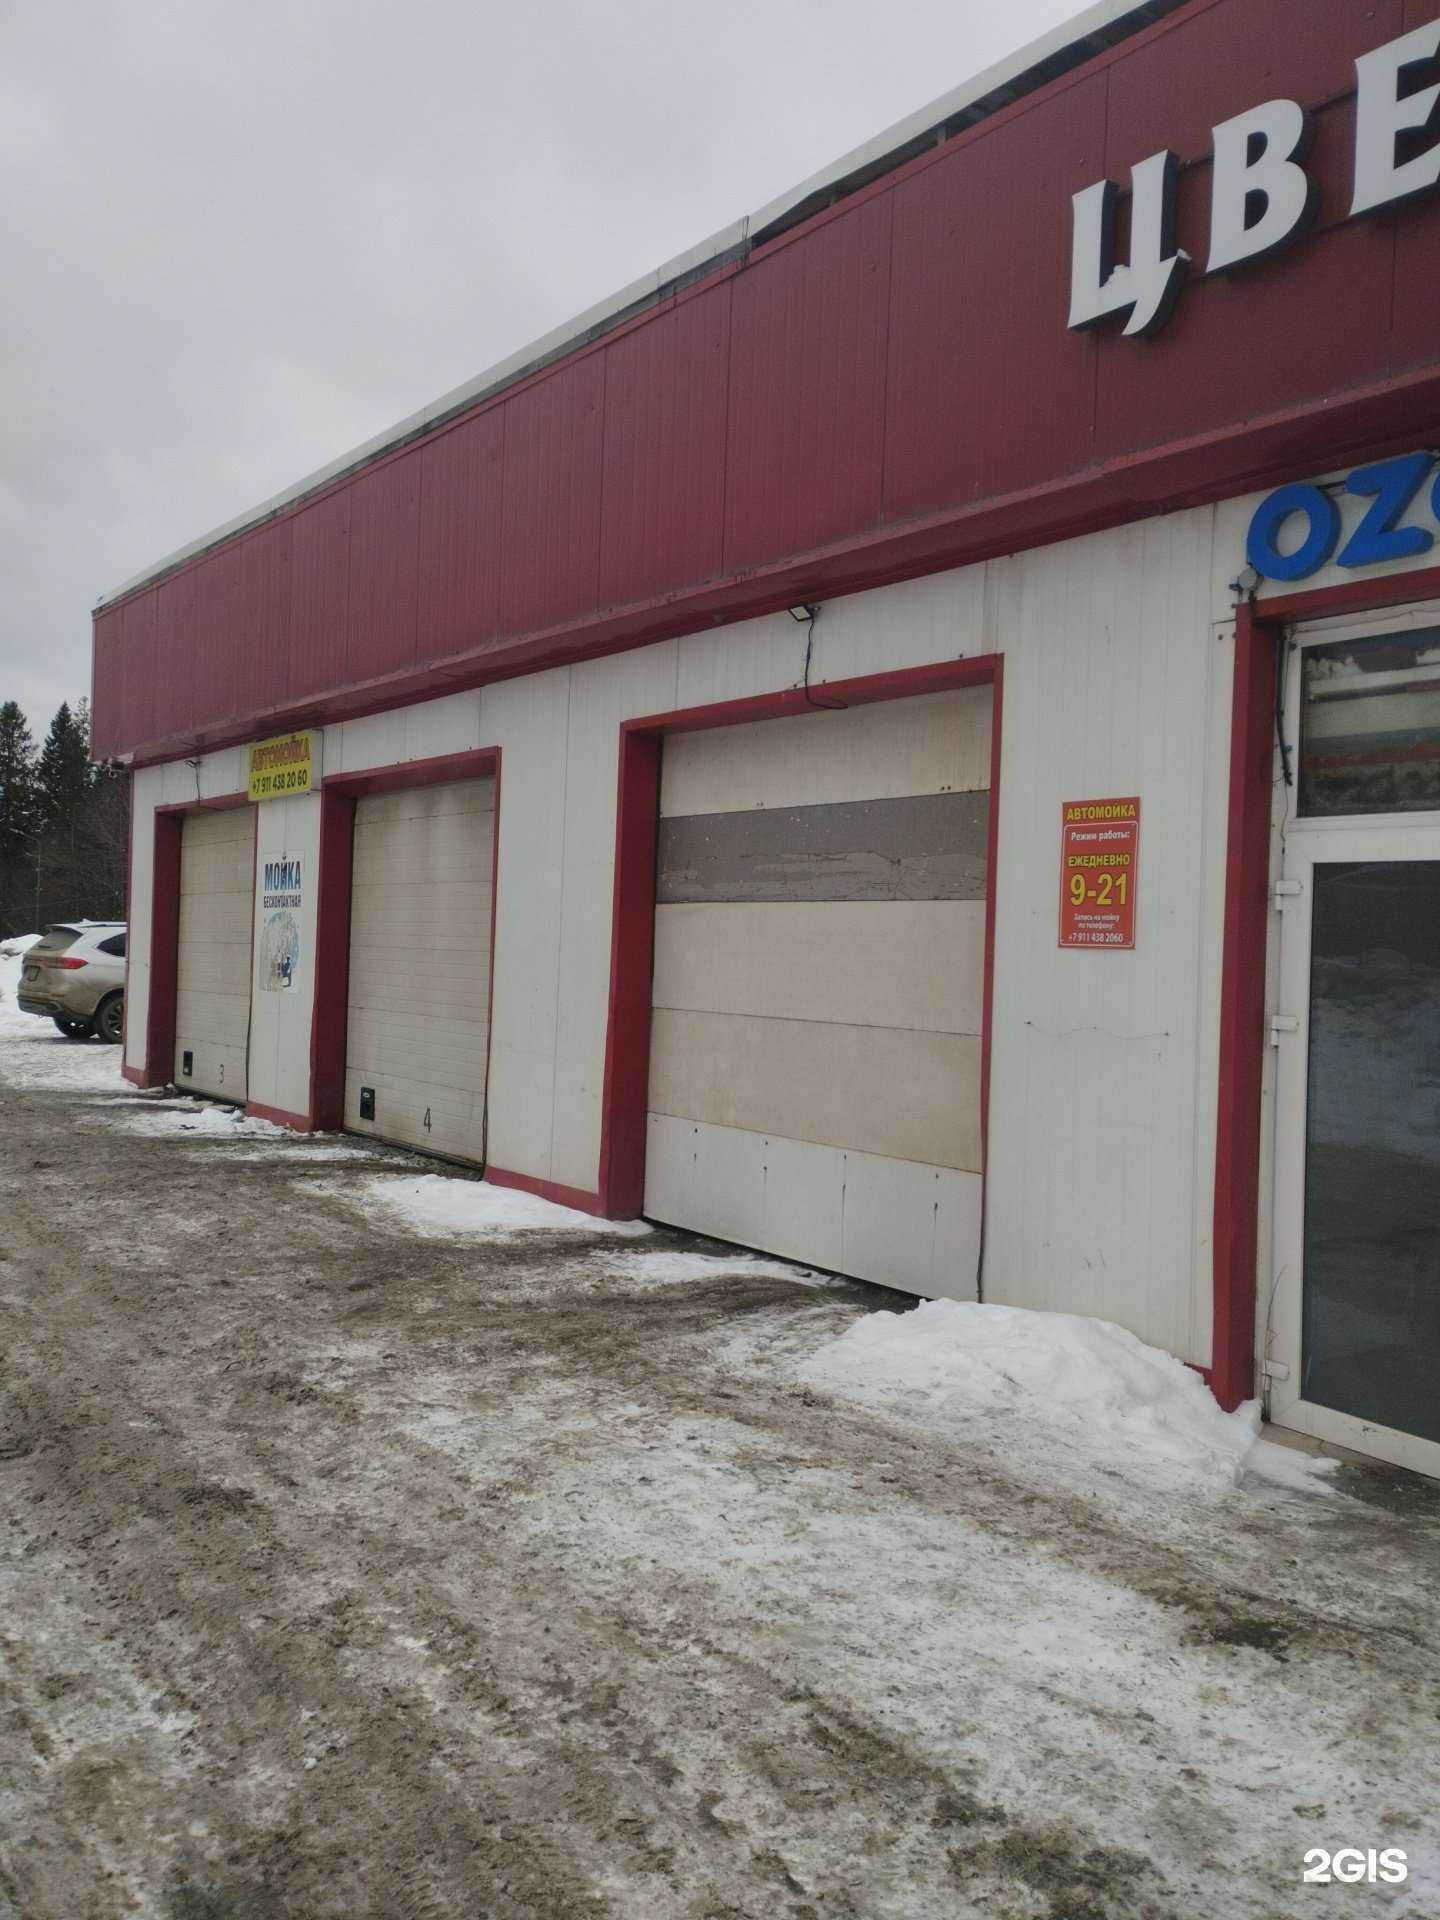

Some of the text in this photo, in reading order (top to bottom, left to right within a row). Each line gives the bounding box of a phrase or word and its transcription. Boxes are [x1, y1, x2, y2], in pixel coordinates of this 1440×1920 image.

[1246, 450, 1440, 582] OZ
[261, 776, 271, 793] 911
[272, 773, 285, 792] 438
[287, 771, 295, 789] 20
[297, 768, 307, 786] 60
[1066, 803, 1136, 820] АВТОМОЙКА
[264, 856, 301, 891] МОЙКА
[1068, 854, 1130, 868] ЕЖЕДНЕВНО
[1070, 872, 1127, 906] 9-21
[423, 1106, 433, 1133] 4
